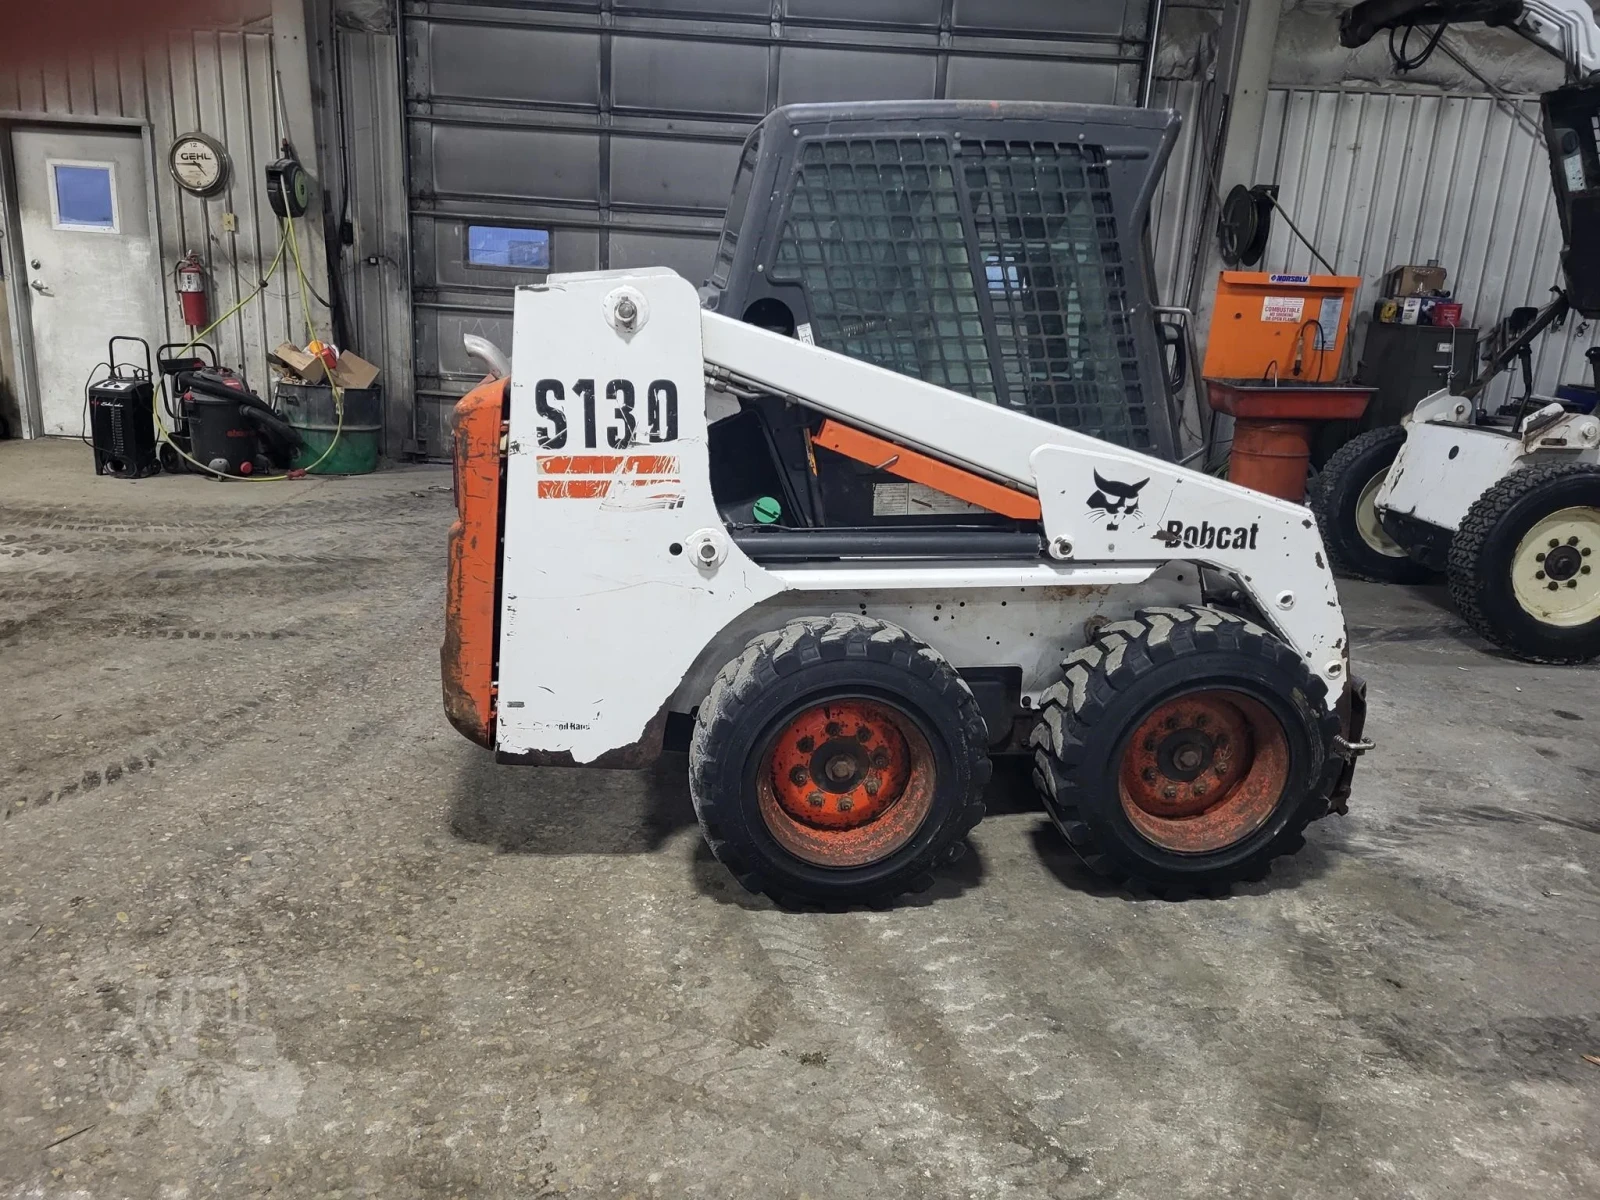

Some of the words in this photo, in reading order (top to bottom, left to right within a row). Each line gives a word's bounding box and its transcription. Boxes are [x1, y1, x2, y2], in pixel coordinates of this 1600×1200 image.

[180, 152, 212, 160] GEHL
[1276, 275, 1309, 283] NORSOLV
[535, 378, 679, 450] S130
[1164, 520, 1259, 550] Bobcat
